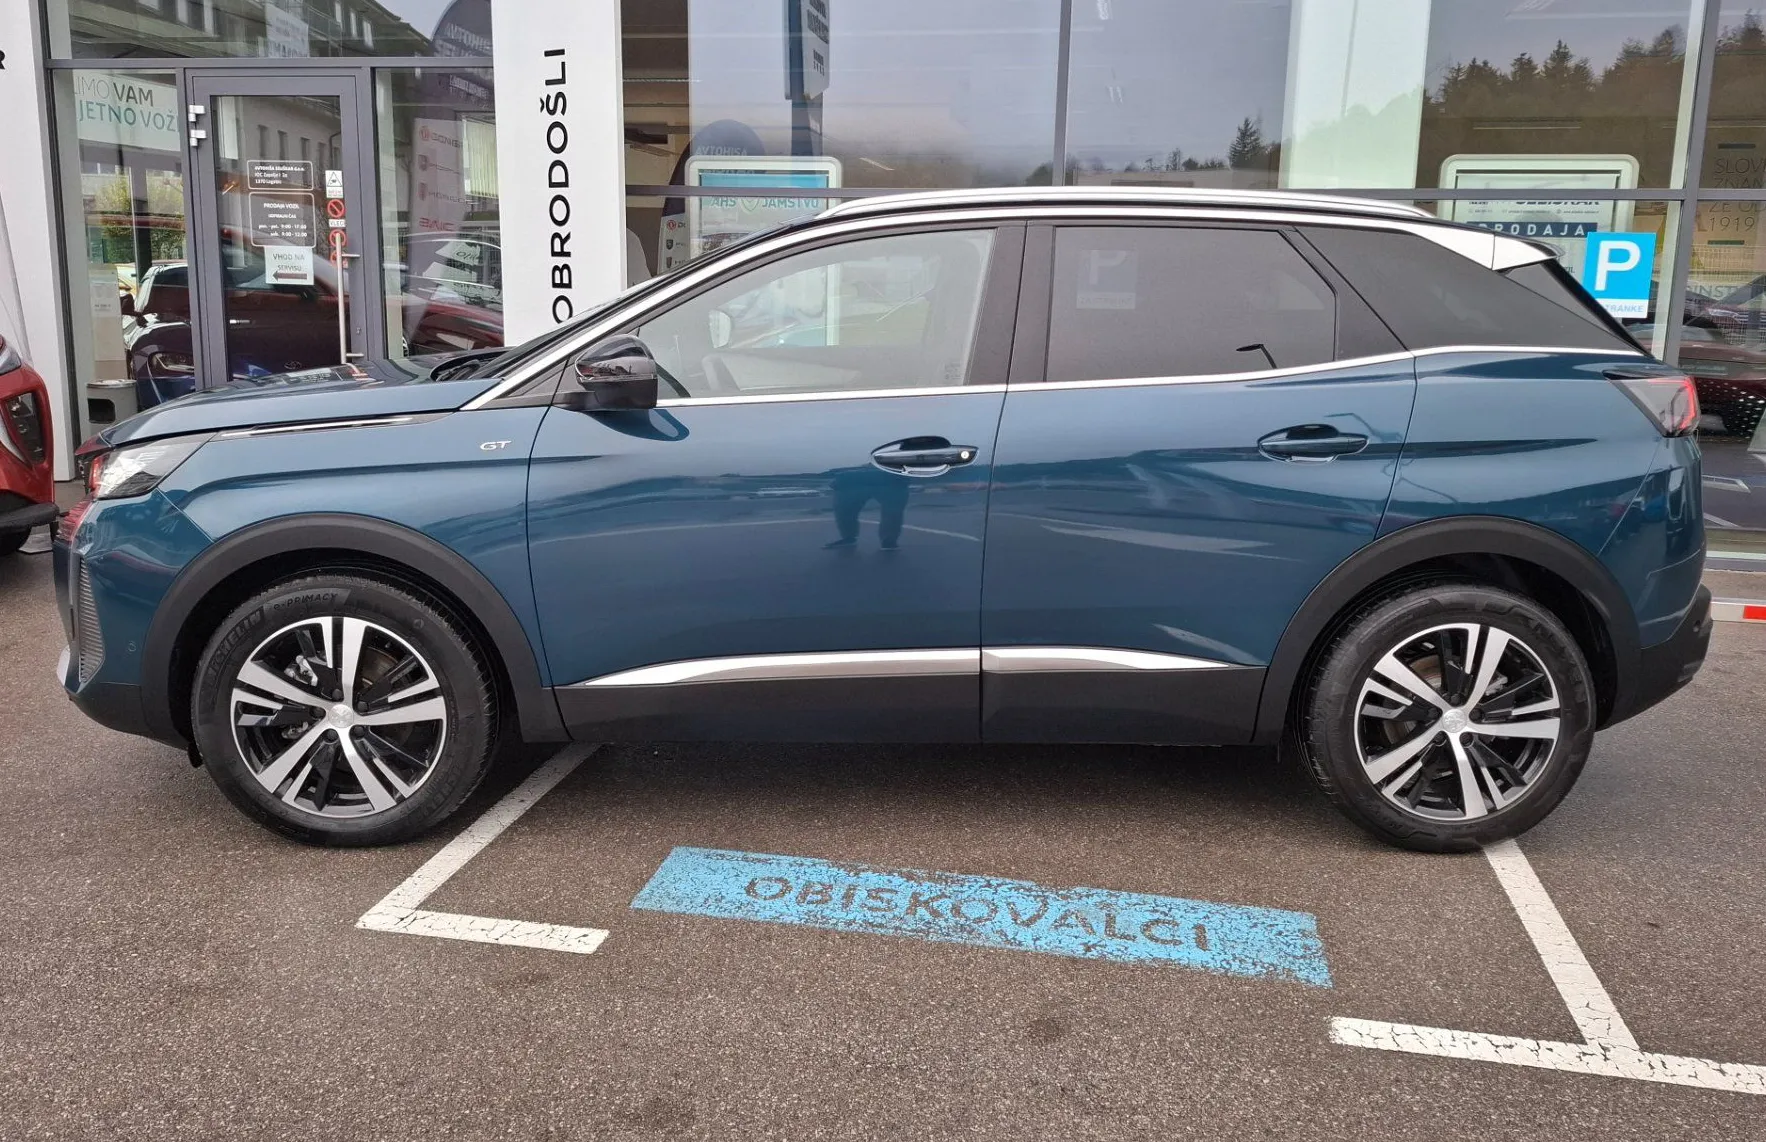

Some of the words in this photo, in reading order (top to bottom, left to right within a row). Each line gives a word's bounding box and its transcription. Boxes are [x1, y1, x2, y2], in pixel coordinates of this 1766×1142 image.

[74, 76, 110, 99] IMO
[113, 82, 153, 107] VAM
[140, 109, 180, 132] VOŽ
[1714, 158, 1766, 174] SLOV
[1709, 216, 1755, 232] 1919
[272, 253, 293, 261] VHOD
[1595, 240, 1641, 291] P
[480, 440, 512, 451] GT
[743, 875, 1211, 952] OBISKOVALCI
